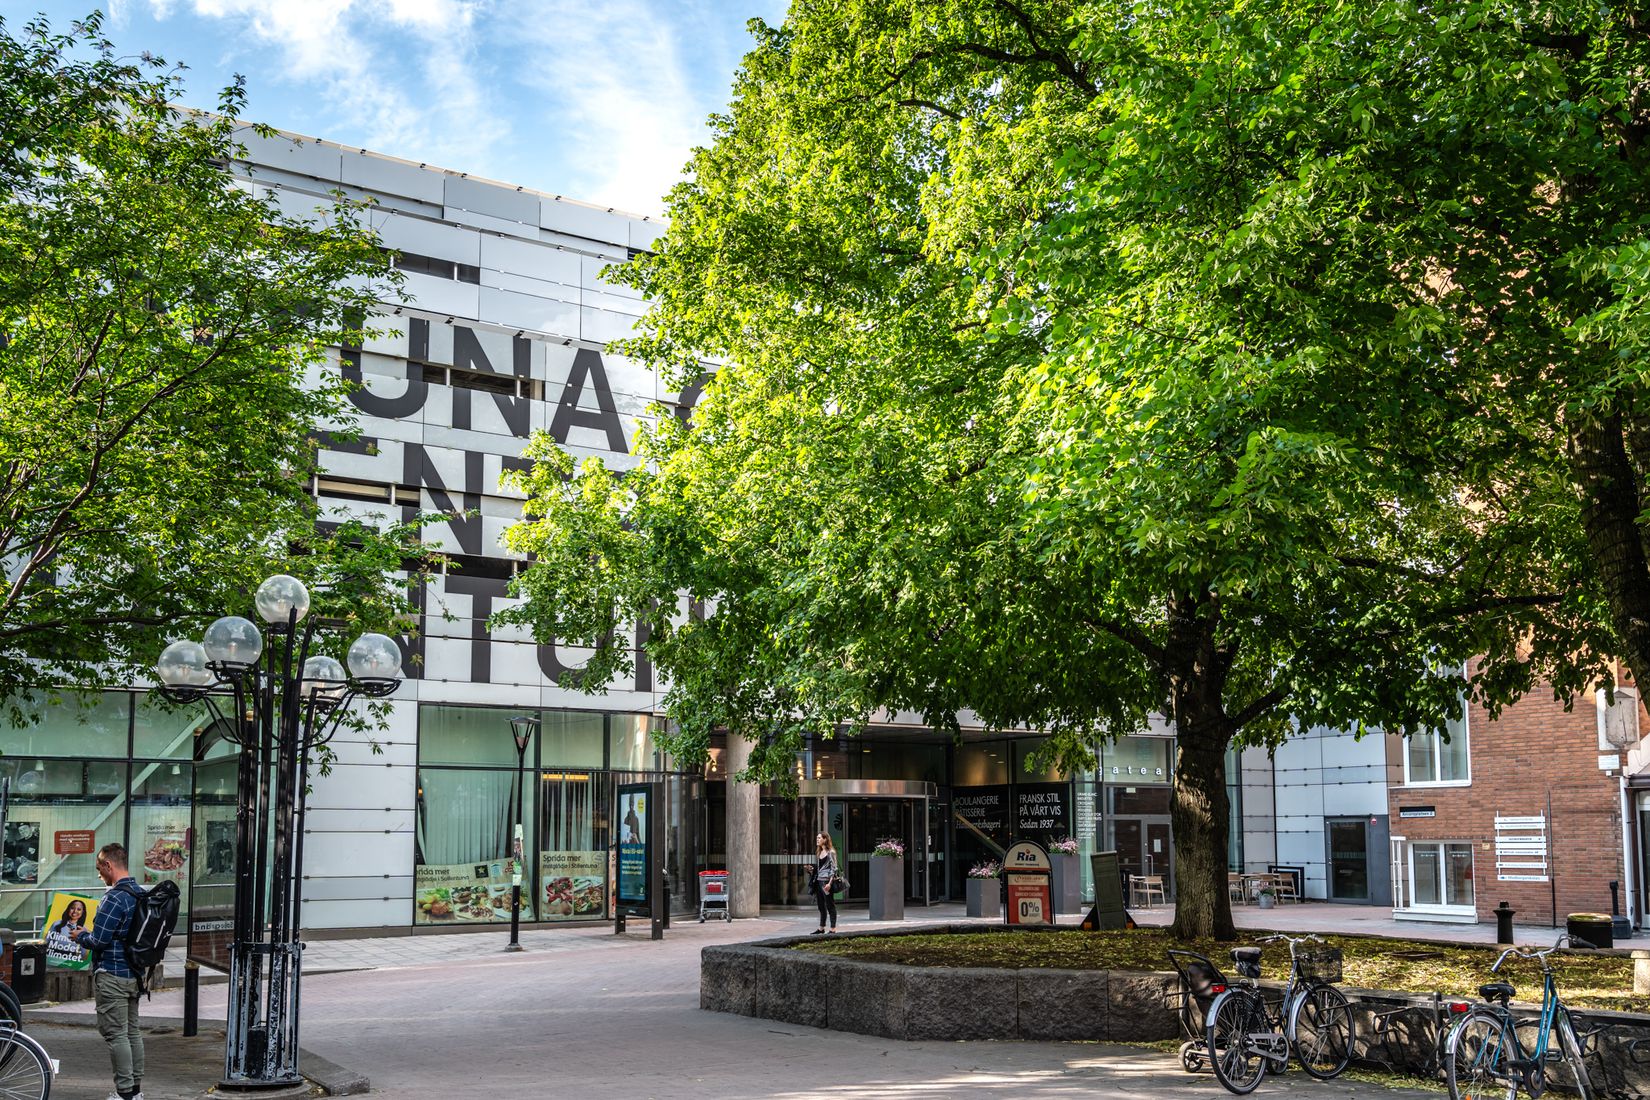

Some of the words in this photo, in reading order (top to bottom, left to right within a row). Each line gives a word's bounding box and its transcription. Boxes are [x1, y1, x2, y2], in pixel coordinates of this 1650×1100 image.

[1019, 793, 1045, 804] FRANSK
[1047, 792, 1061, 803] STIL
[1019, 804, 1029, 816] PÅ
[1030, 804, 1048, 816] VÅRT
[1049, 805, 1062, 816] VIS
[1039, 819, 1054, 829] 1937
[543, 854, 565, 863] Sprida
[1016, 850, 1036, 861] Ria
[1020, 901, 1040, 917] 0%
